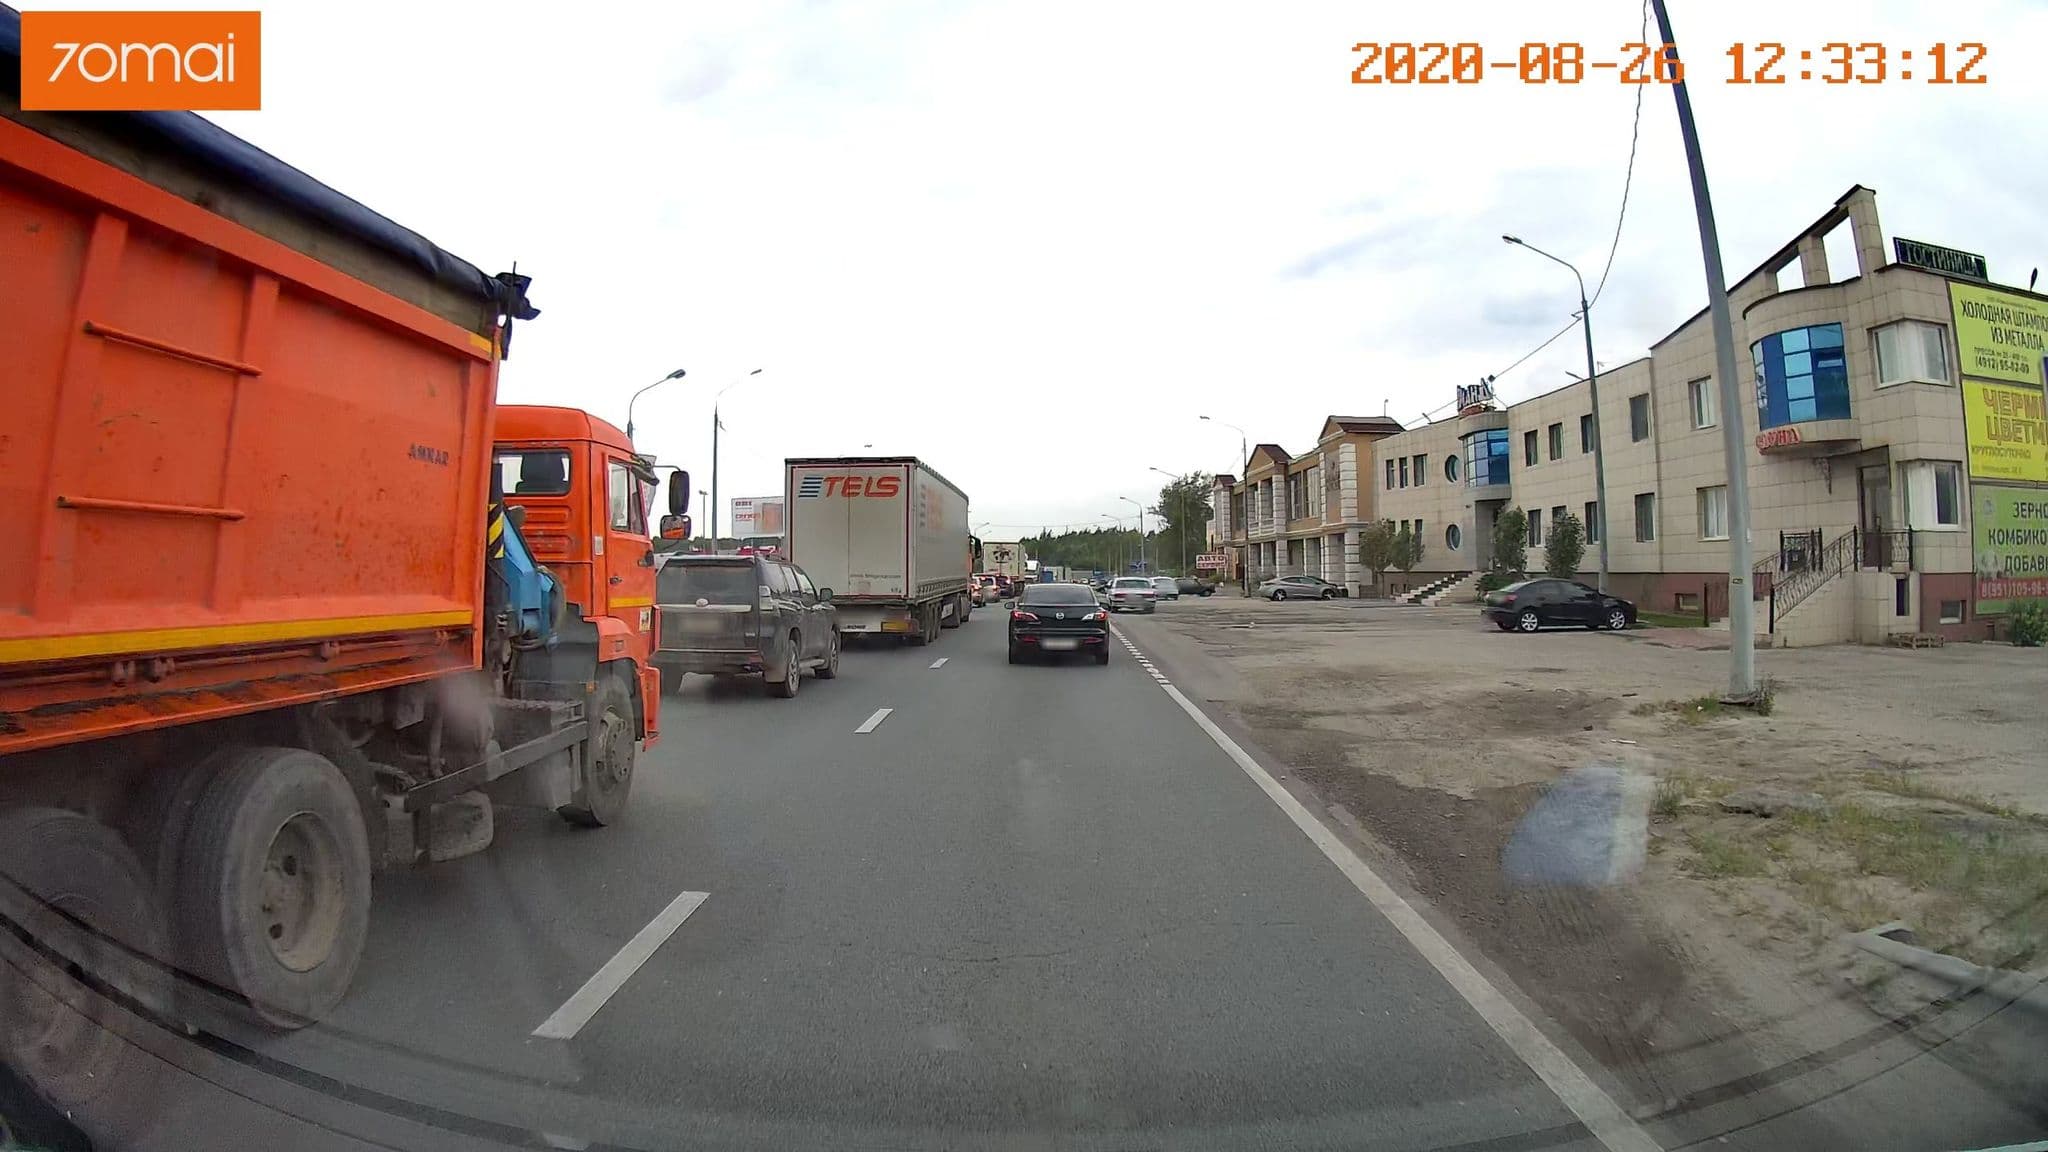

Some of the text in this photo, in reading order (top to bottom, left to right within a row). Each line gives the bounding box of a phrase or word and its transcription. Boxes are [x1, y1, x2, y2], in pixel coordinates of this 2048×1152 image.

[1906, 242, 1981, 277] ГОСТИНИЦА
[1961, 299, 2012, 325] ХОЛОДНАЯ
[1991, 326, 2044, 351] ИЗ МЕТАЛЛА
[1986, 416, 2048, 446] ЦВЕТМ
[823, 475, 901, 498] TELS
[1988, 528, 2048, 546] КОМБИКО
[2004, 554, 2048, 576] ДОБАВ
